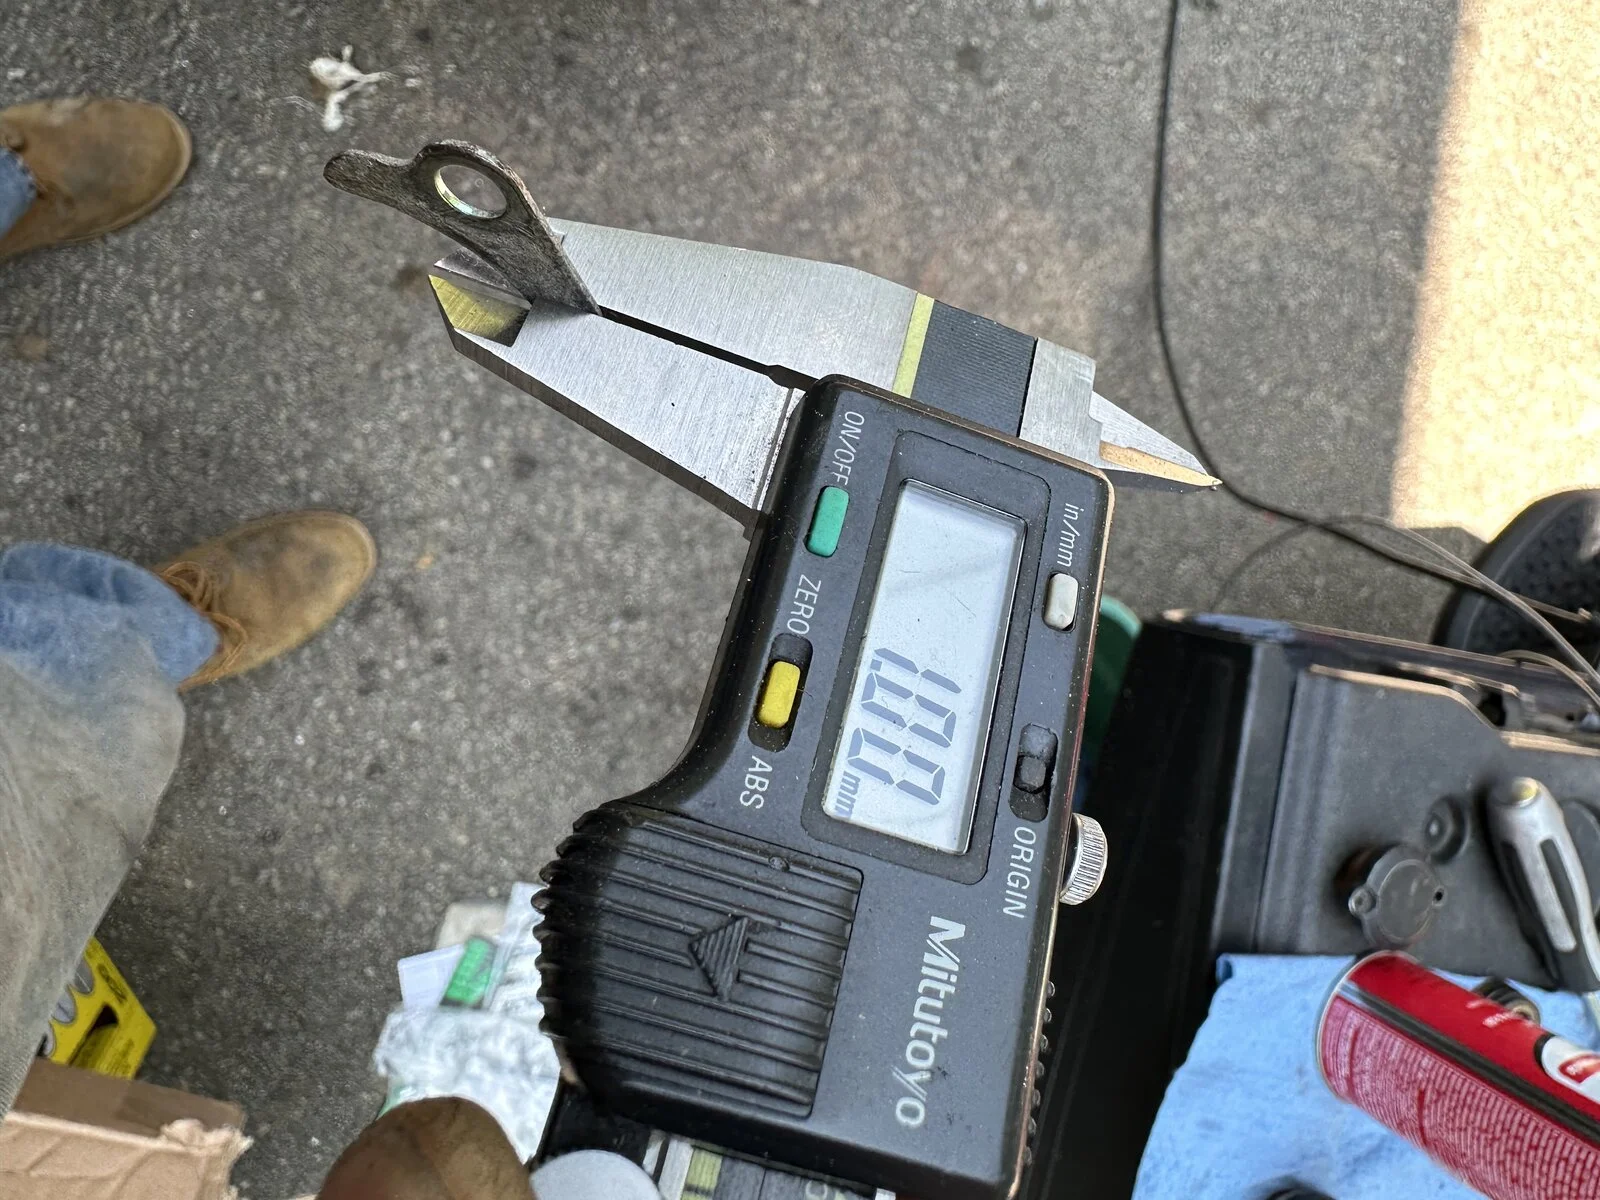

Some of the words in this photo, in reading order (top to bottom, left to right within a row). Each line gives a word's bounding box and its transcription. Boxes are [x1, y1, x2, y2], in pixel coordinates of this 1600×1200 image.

[832, 411, 865, 485] ON/OFF
[1057, 503, 1084, 567] in/mm
[787, 574, 821, 635] ZERO
[847, 648, 962, 805] 1.00
[739, 755, 773, 809] ABS
[835, 770, 861, 816] mm
[1003, 826, 1037, 918] ORIGIN
[892, 915, 966, 1127] Mitutoyo
